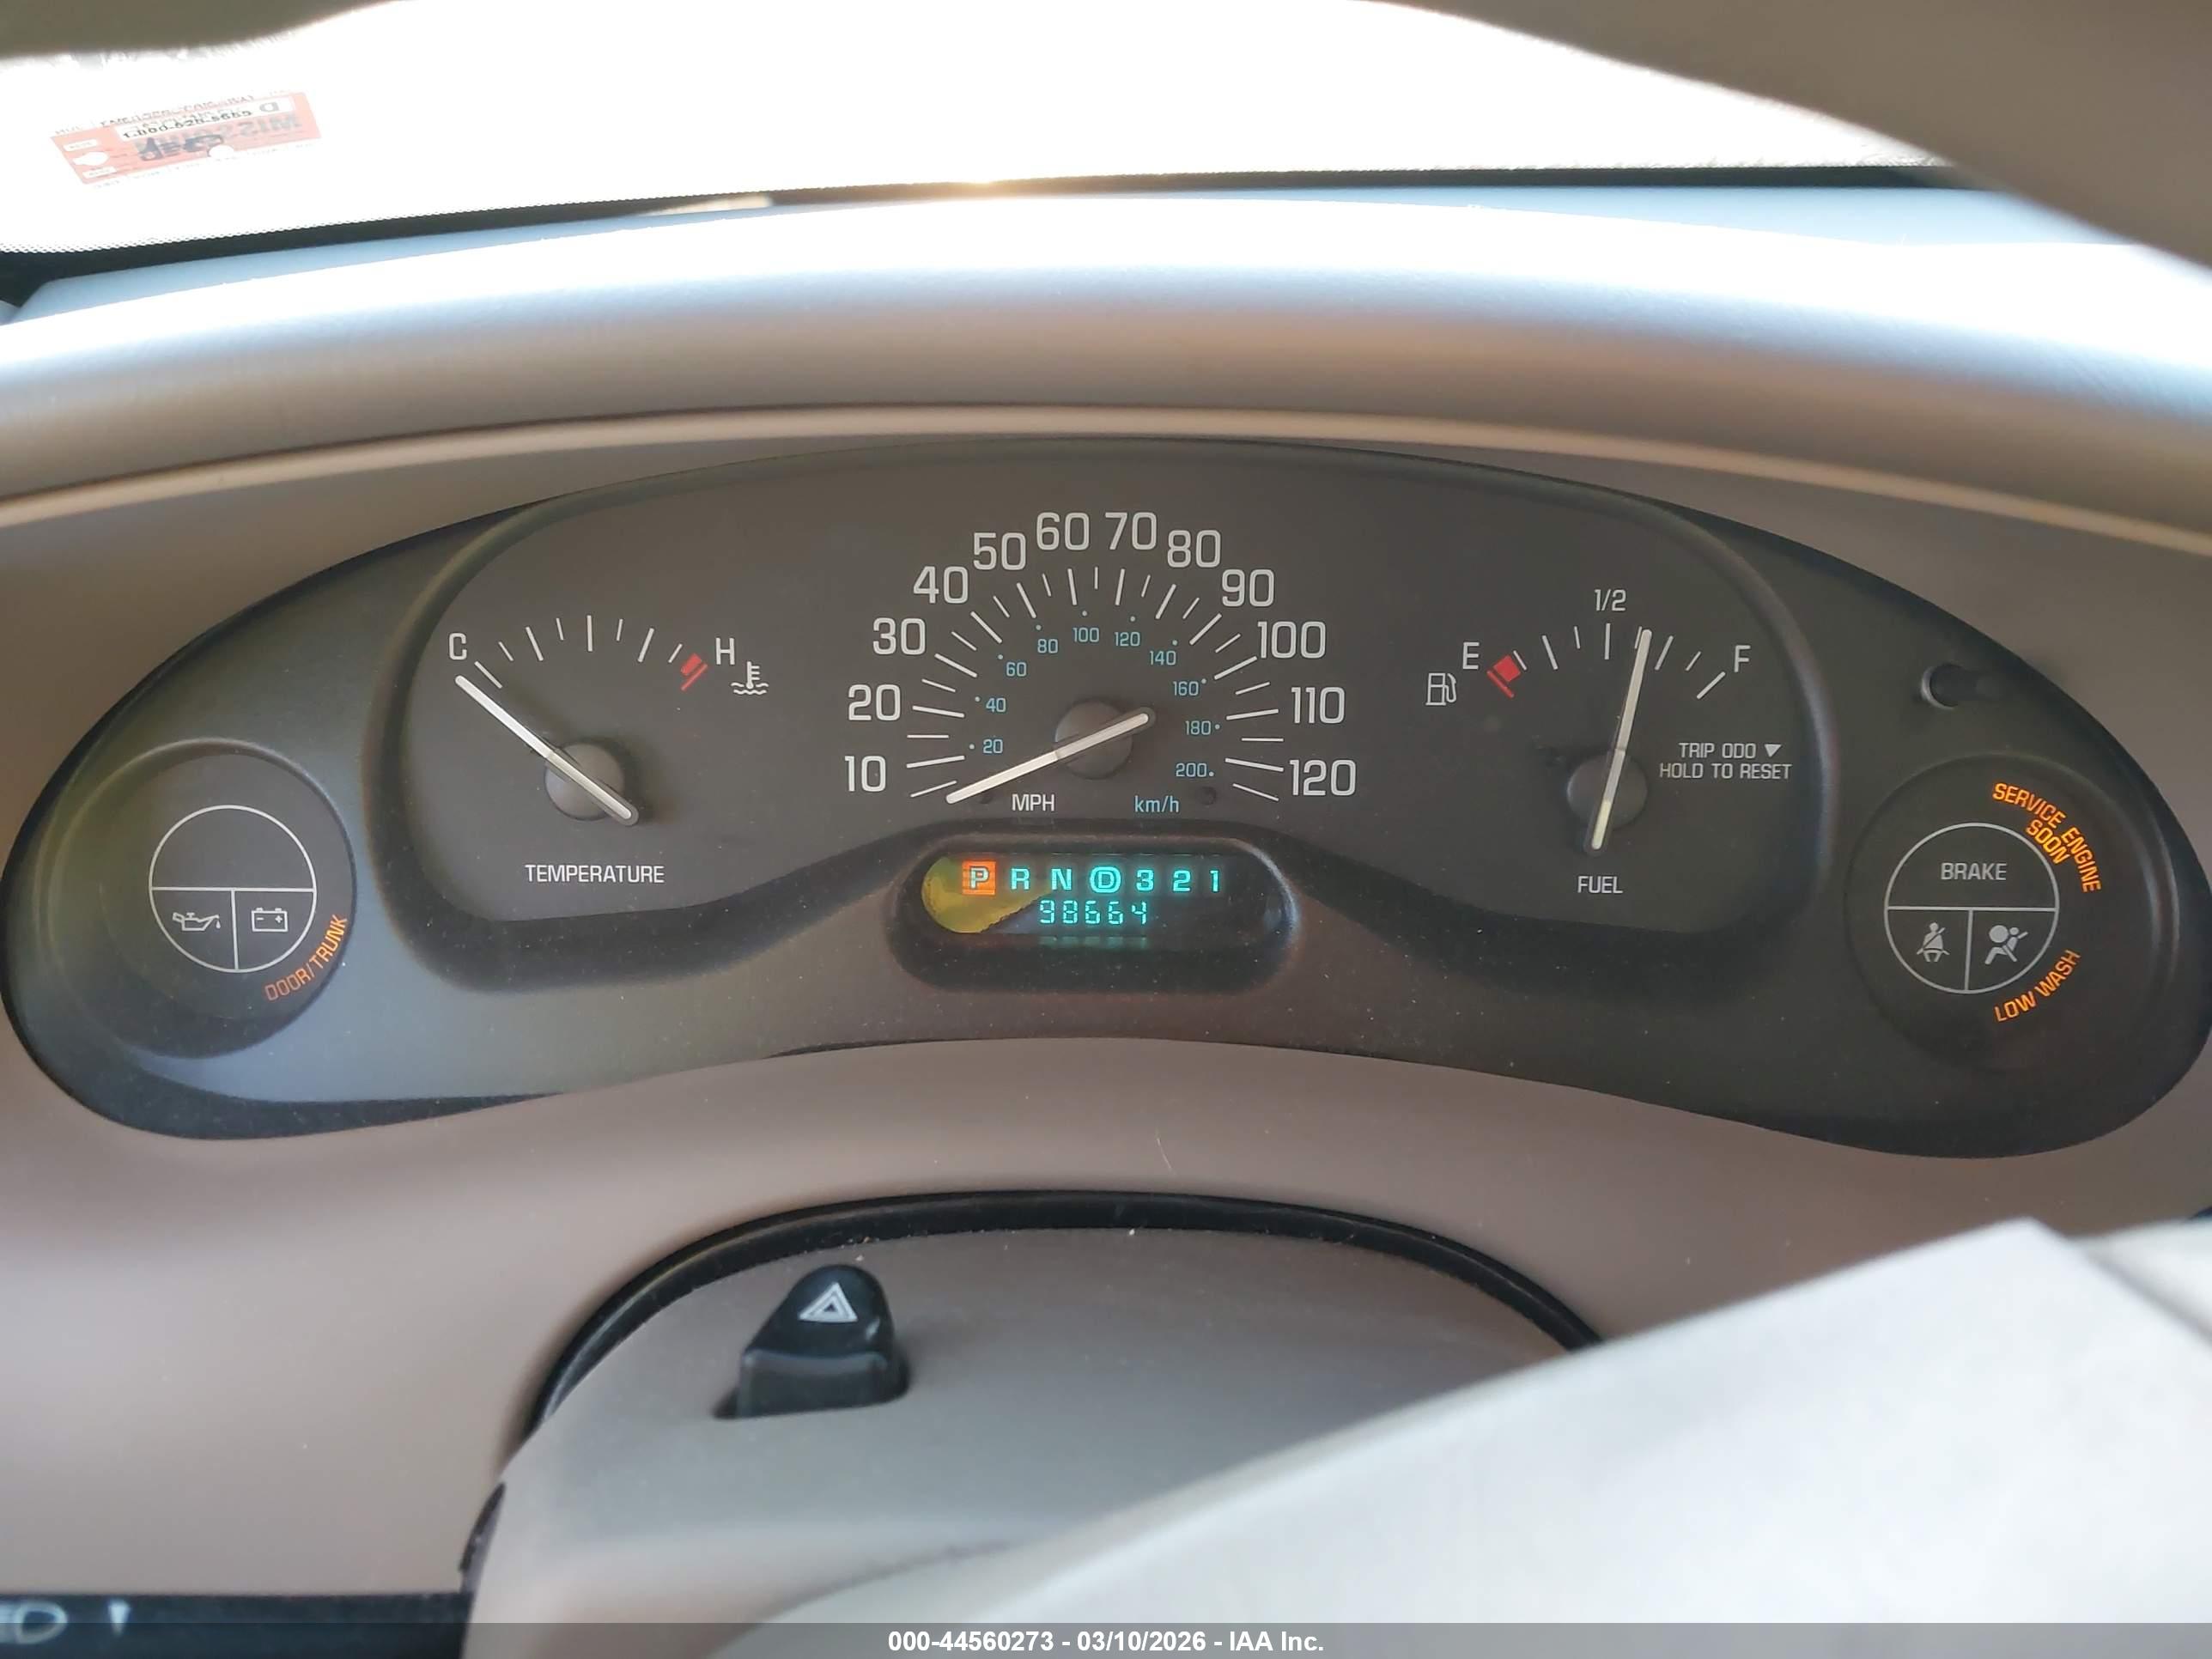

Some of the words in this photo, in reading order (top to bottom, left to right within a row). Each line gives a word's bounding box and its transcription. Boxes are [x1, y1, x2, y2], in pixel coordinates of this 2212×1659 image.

[1036, 512, 1091, 551] 60
[1105, 512, 1158, 550] 70
[972, 532, 1027, 570] 50
[1167, 529, 1222, 568] 80
[913, 566, 969, 604] 40
[1221, 568, 1275, 607] 90
[1594, 589, 1626, 611] 1/2
[448, 632, 469, 660] C
[872, 617, 926, 655] 30
[1036, 638, 1059, 654] 80
[1073, 627, 1100, 643] 100
[1114, 631, 1141, 647] 120
[1257, 620, 1327, 659] 100
[714, 637, 736, 665] H
[1149, 650, 1176, 666] 140
[1462, 641, 1480, 670] E
[1733, 645, 1751, 672] F
[1006, 662, 1027, 678] 60
[1172, 681, 1200, 696] 160
[848, 684, 902, 721] 20
[985, 697, 1006, 714] 40
[1291, 686, 1346, 724] 110
[1185, 720, 1212, 736] 180
[982, 738, 1004, 754] 20
[1678, 743, 1714, 759] TRIP
[1722, 744, 1756, 759] ODO
[844, 755, 886, 792] 10
[1176, 762, 1208, 777] 200
[1289, 759, 1357, 797] 120
[1659, 763, 1703, 779] HOLD
[1711, 763, 1733, 779] TO
[1740, 763, 1791, 779] RESET
[1012, 794, 1055, 811] MPH
[1134, 795, 1180, 813] km/h
[1991, 782, 2066, 829] SERVICE
[2061, 827, 2101, 892] ENGINE
[2026, 819, 2070, 866] SOON
[525, 864, 665, 884] TEMPERATURE
[969, 867, 989, 888] P
[1011, 868, 1030, 890] R
[1051, 868, 1073, 890] N
[1136, 870, 1154, 891] 3
[1172, 870, 1192, 891] 2
[1210, 871, 1220, 891] 1
[1941, 862, 2008, 881] BRAKE
[1577, 876, 1623, 894] FUEL
[1039, 900, 1148, 925] 98664
[264, 914, 348, 1001] DOOR/TRUNK
[1994, 991, 2037, 1022] LOW
[2034, 949, 2081, 997] WASH
